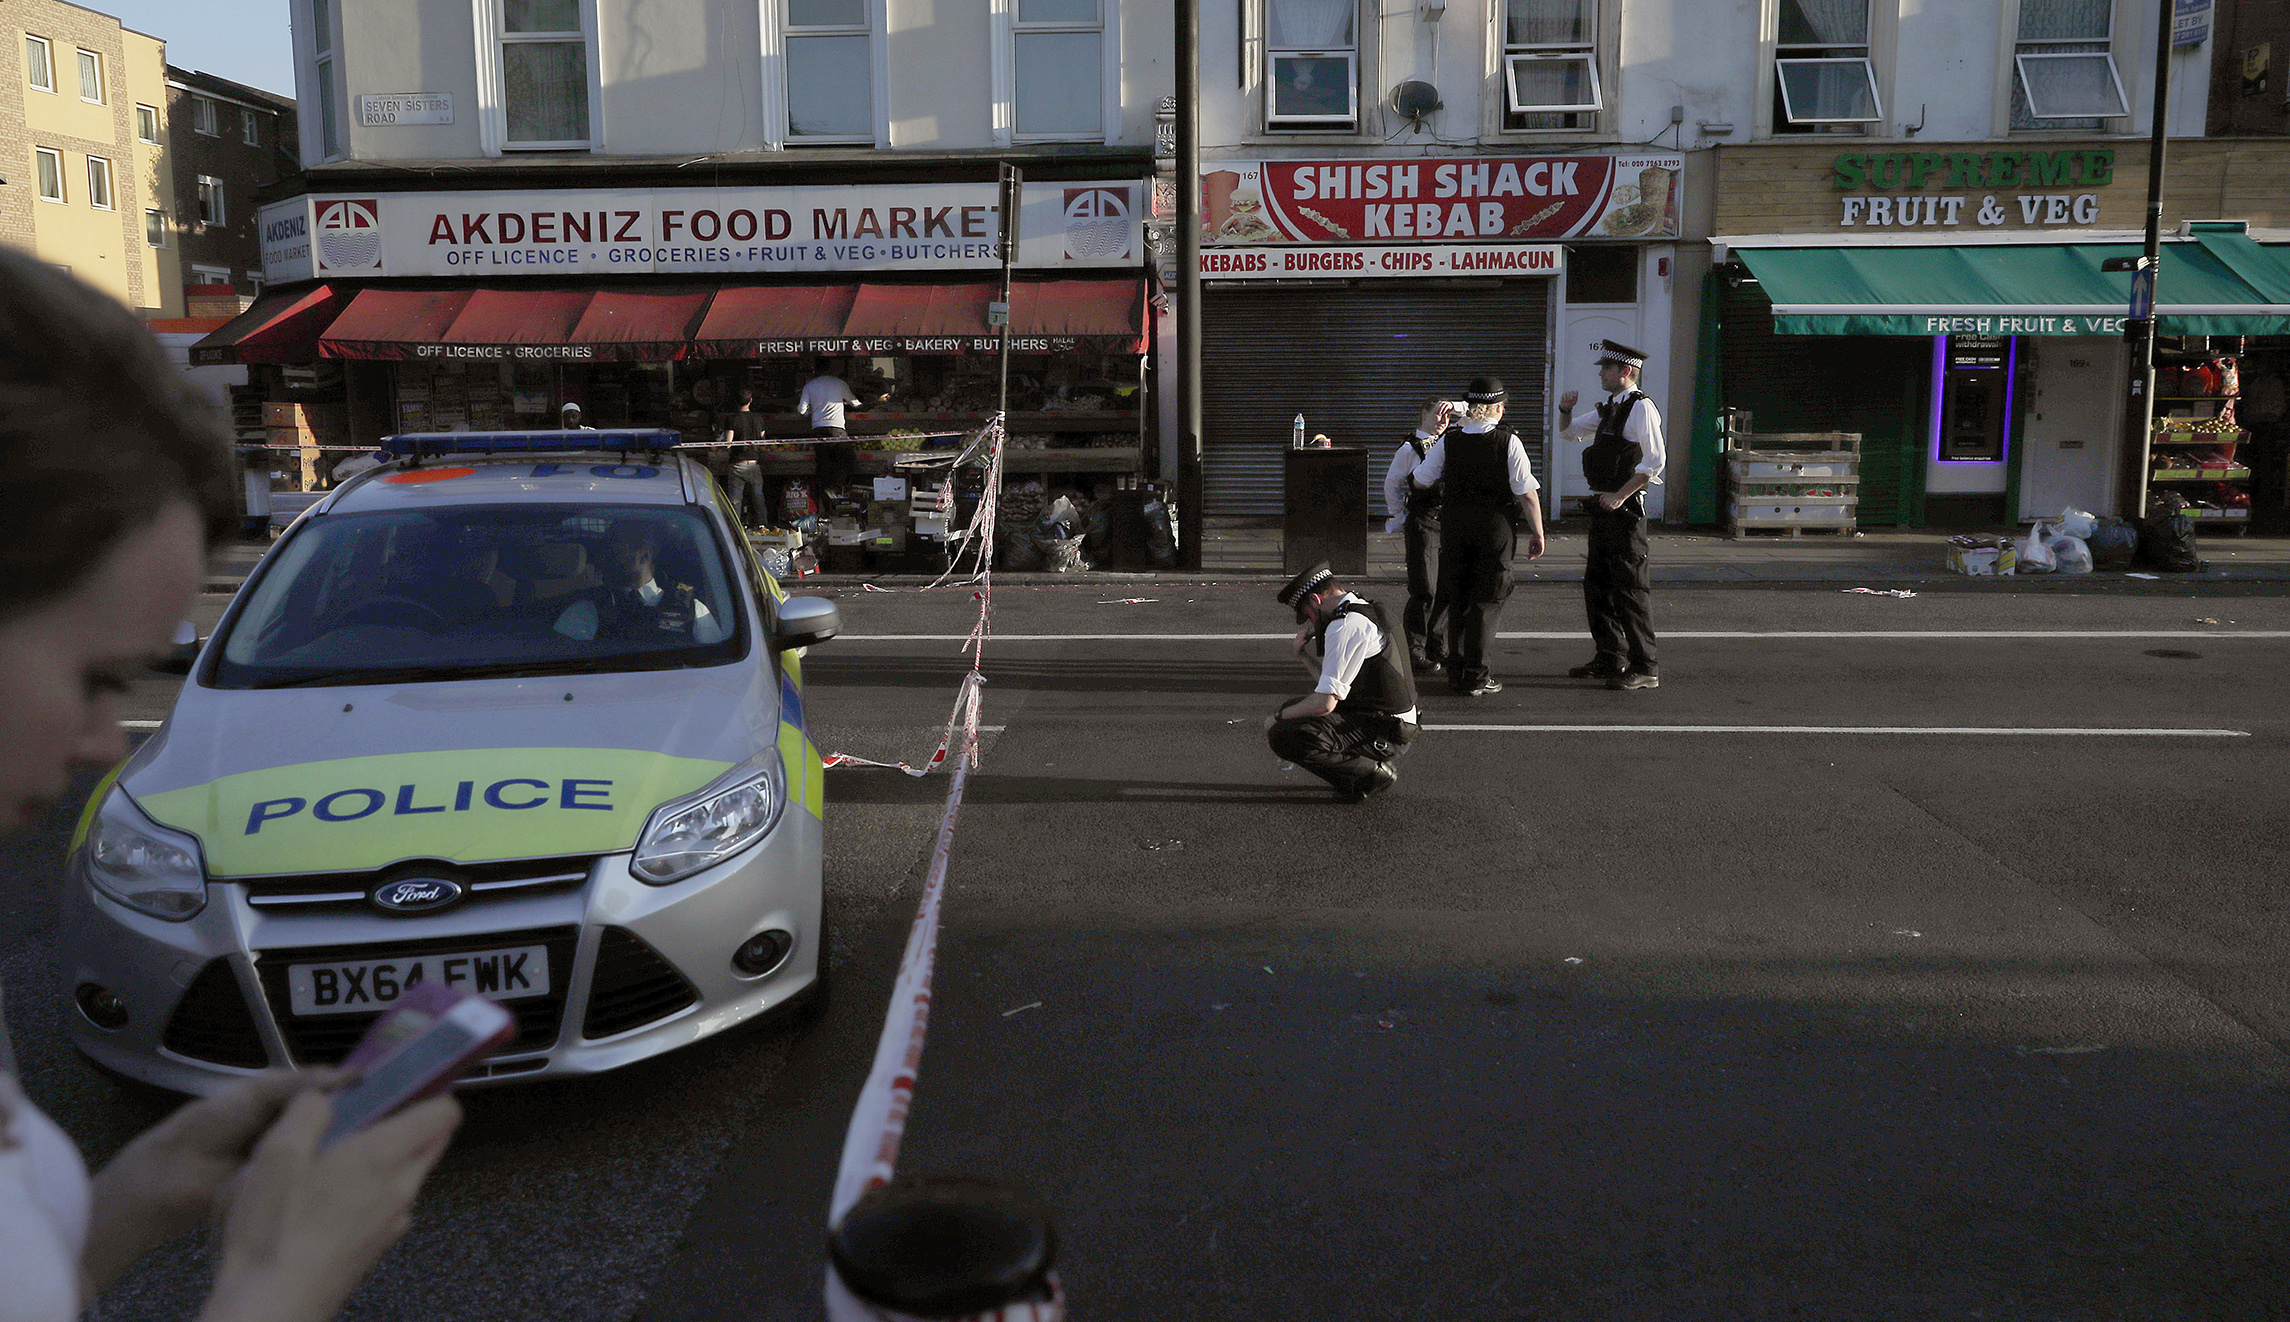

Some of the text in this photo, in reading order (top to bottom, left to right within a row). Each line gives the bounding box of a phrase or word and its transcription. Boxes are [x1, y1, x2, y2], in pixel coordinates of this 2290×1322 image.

[366, 99, 449, 112] SEVEN SISTERS
[367, 113, 397, 124] ROAD
[1663, 159, 1680, 167] 8793
[1833, 149, 2115, 189] SUPREME
[1242, 171, 1259, 181] 167
[1293, 161, 1580, 200] SHISH SHACK
[1364, 200, 1506, 238] KEBAB
[1840, 193, 2100, 227] FRUIT & VEG
[265, 215, 306, 243] AKDENIZ
[428, 210, 642, 246] AKDENIZ
[661, 208, 792, 242] FOOD
[265, 244, 311, 266] FOOD MARKET
[446, 250, 484, 265] OFF
[492, 249, 579, 264] LICENCE
[608, 247, 731, 263] GROCERIES
[748, 246, 808, 262] FRUIT
[815, 245, 827, 261] &
[837, 245, 876, 260] VEG
[1200, 250, 1554, 272] KEBABS BURGERS CHIPS LAHMACUN
[1926, 317, 1991, 333] FRESH
[1999, 317, 2056, 333] FRUIT
[2062, 318, 2078, 333] &
[416, 345, 593, 359] OFF LICENCE GROCERIES
[758, 341, 804, 354] FRESH
[809, 340, 848, 352] FRUIT
[851, 340, 862, 351] &
[865, 339, 893, 351] VEG
[905, 338, 961, 351] BAKERY
[1588, 342, 1606, 351] 167
[244, 777, 614, 836] POLICE
[392, 882, 440, 904] Ford
[311, 962, 424, 1007] BX64
